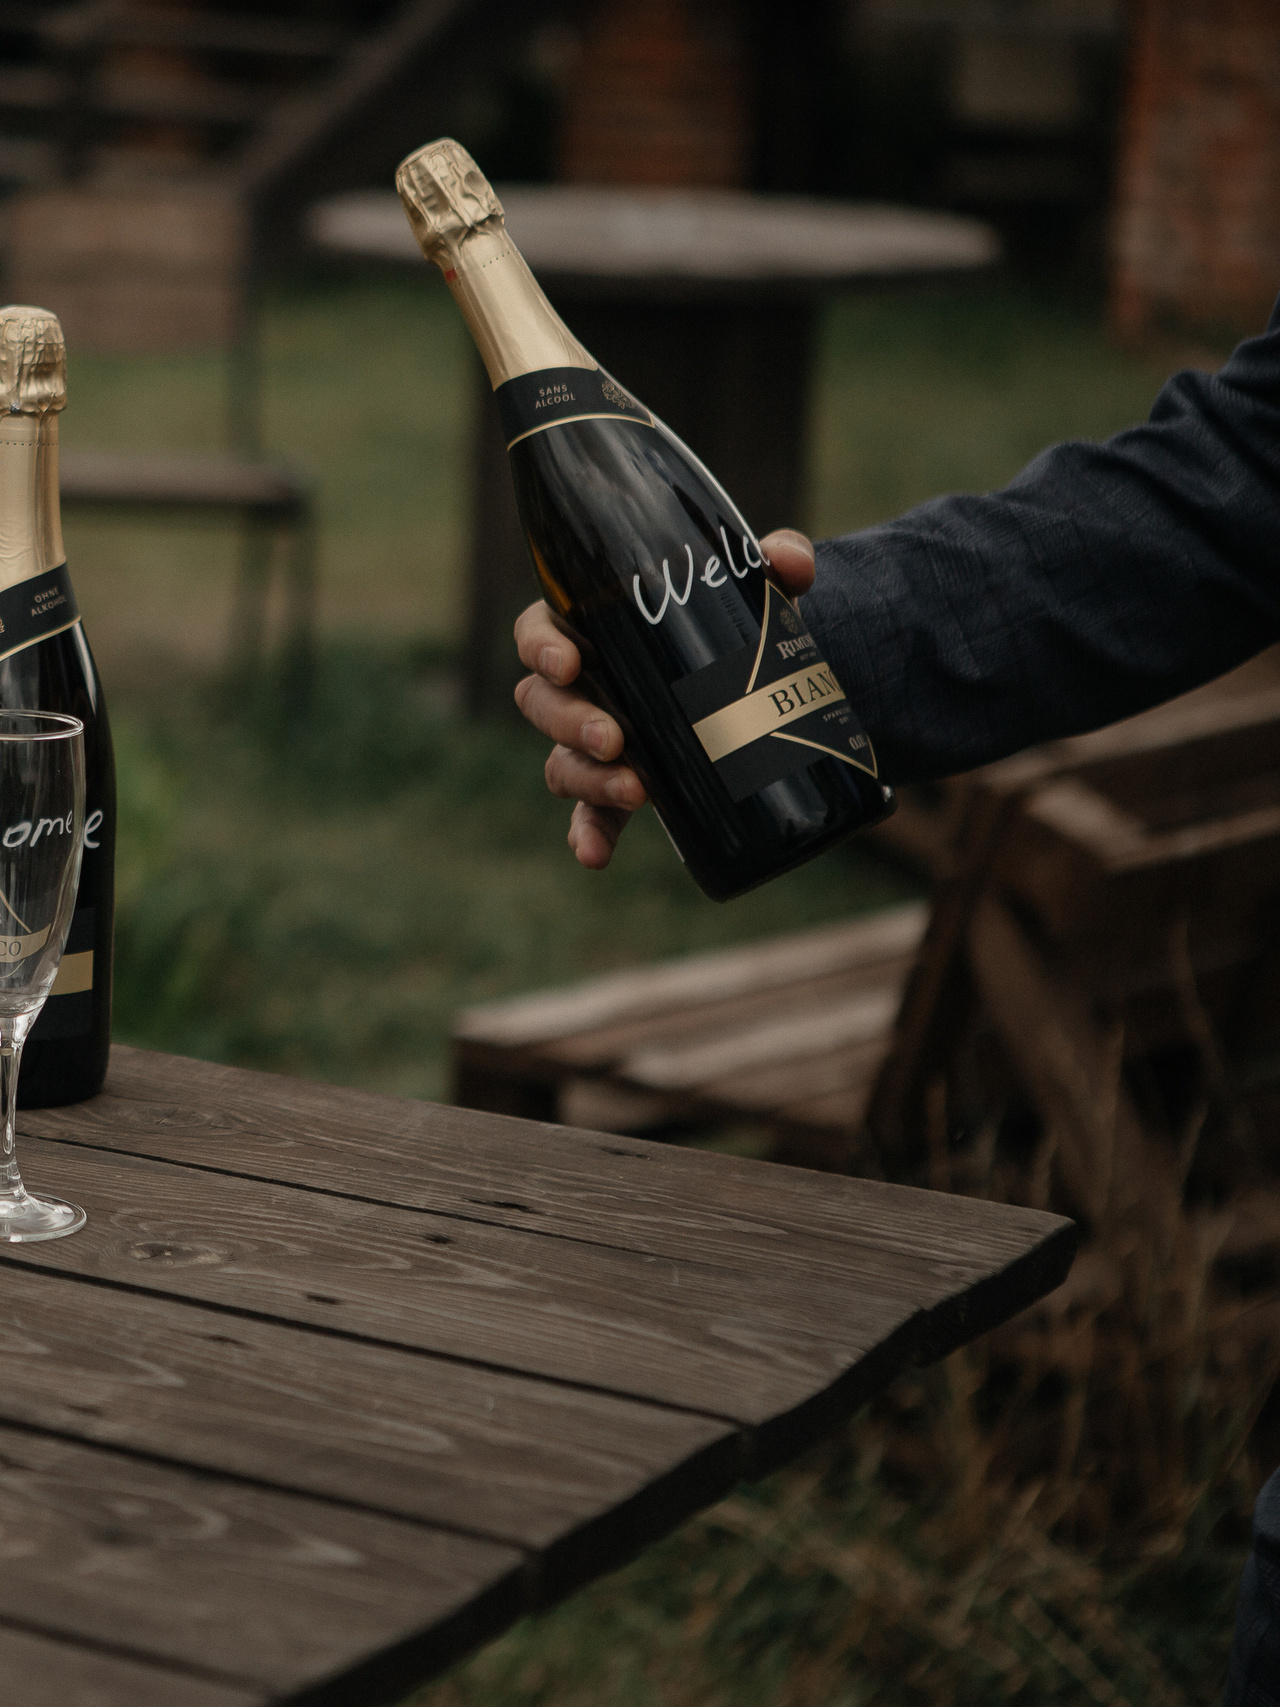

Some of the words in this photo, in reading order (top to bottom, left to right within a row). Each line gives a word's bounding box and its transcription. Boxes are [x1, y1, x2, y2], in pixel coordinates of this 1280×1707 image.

[539, 384, 568, 398] SANS
[535, 392, 576, 409] ALCOOL
[34, 587, 59, 603] OHNE
[31, 595, 67, 617] ALKOHOL
